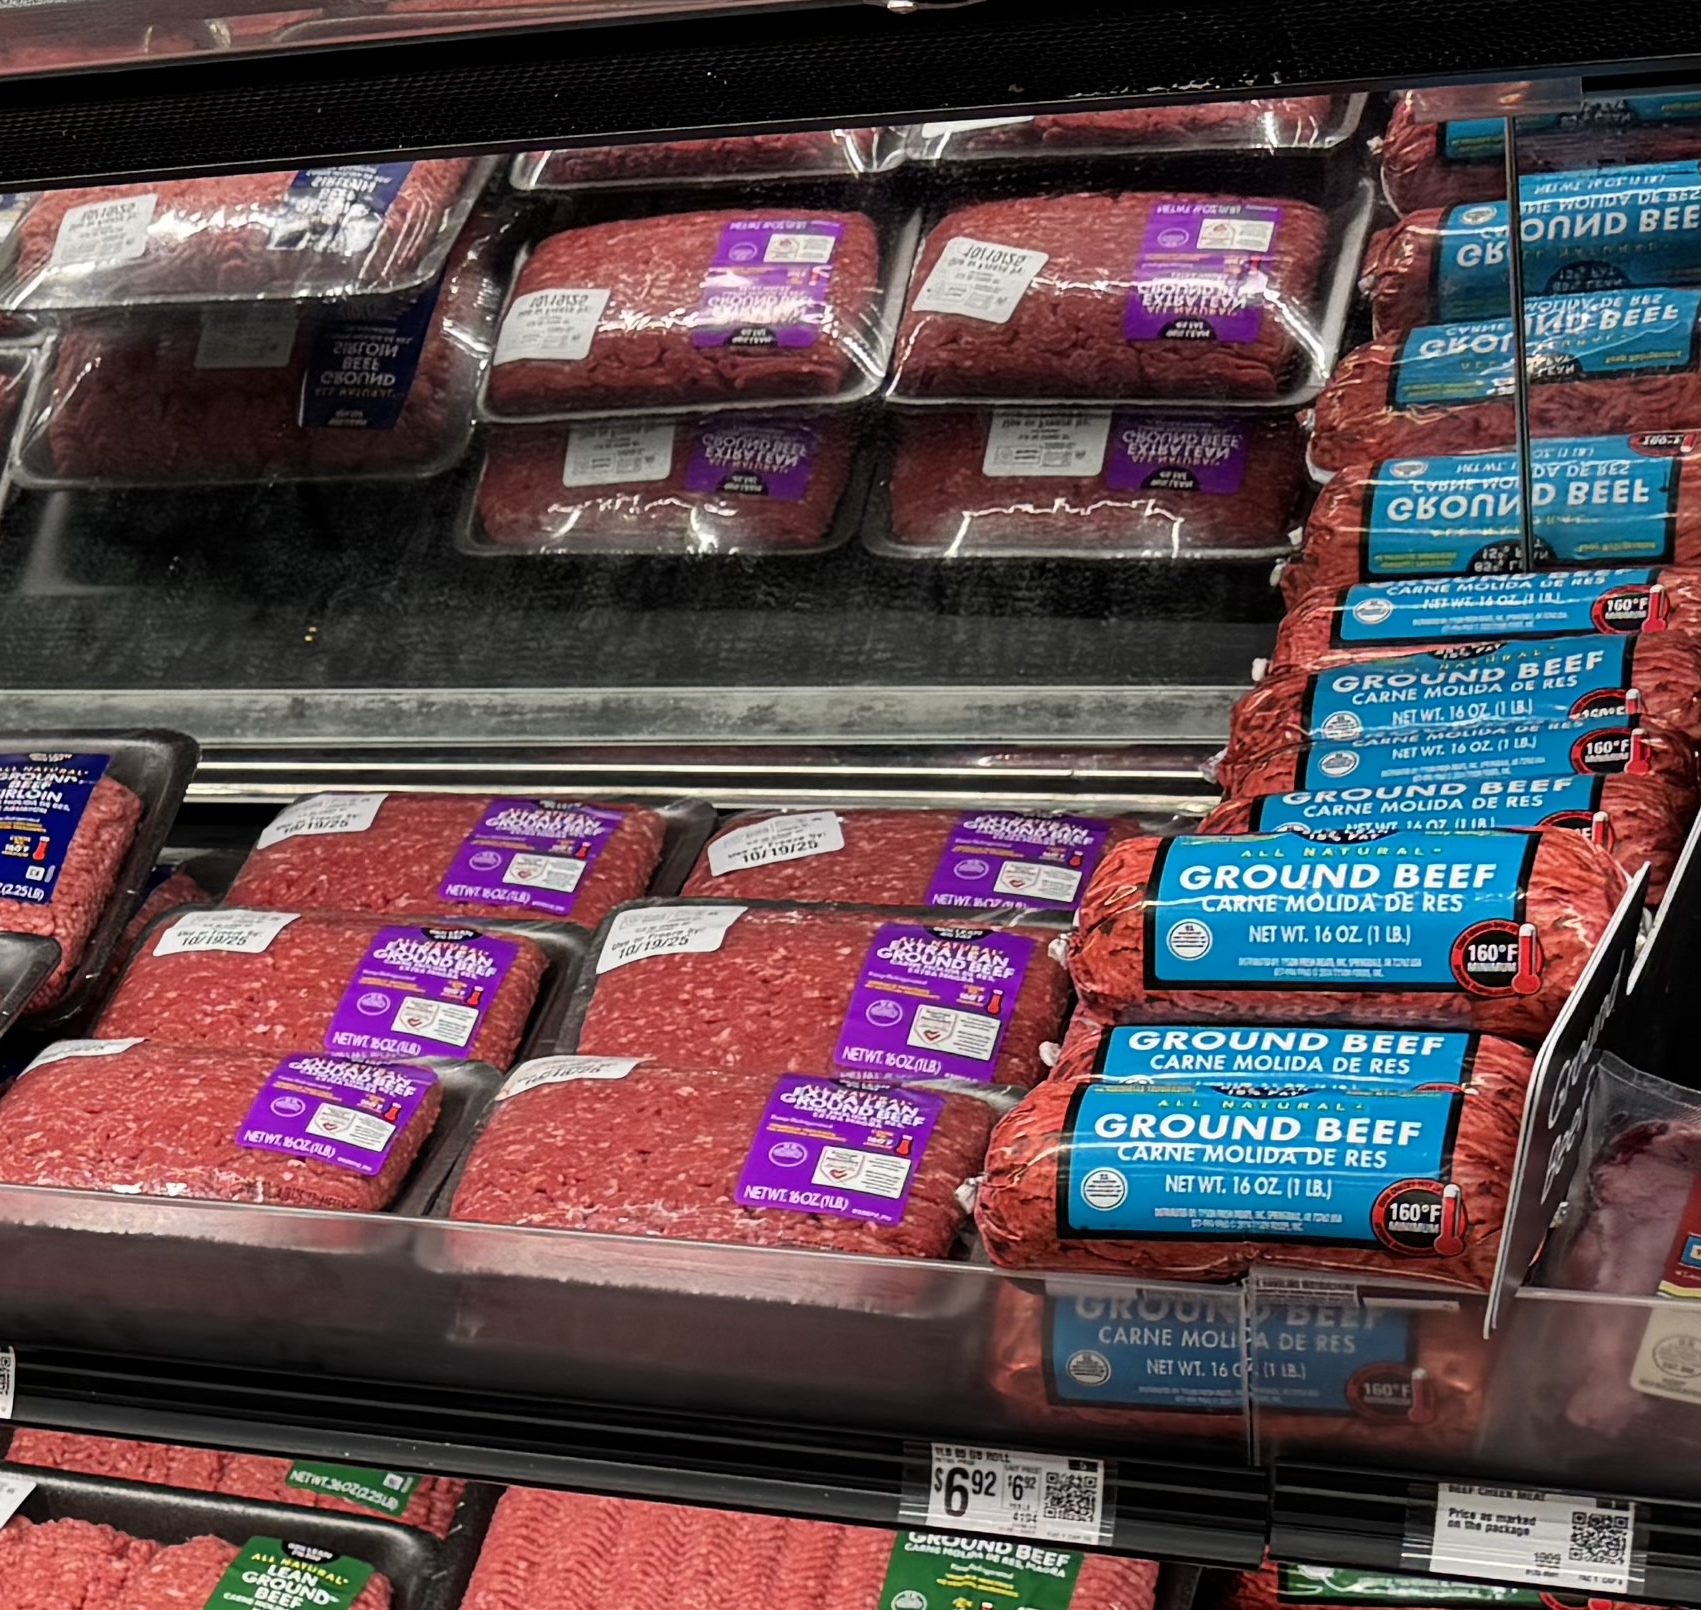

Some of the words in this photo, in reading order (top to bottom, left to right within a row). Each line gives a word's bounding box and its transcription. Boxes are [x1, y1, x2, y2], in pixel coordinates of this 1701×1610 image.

[1332, 668, 1509, 693] GROUND
[1517, 651, 1605, 680] BEEF
[1352, 689, 1417, 706] CARNE
[1425, 683, 1502, 699] MOLIDA
[1510, 680, 1536, 692] DE
[1543, 675, 1578, 690] RES
[1392, 711, 1418, 726] NET
[1420, 709, 1445, 723] WT.
[1449, 706, 1465, 719] 16
[1468, 703, 1491, 718] OZ.
[1282, 783, 1467, 805] GROUND
[1480, 778, 1574, 795] BEEF
[741, 840, 819, 865] 10/19/25
[1180, 863, 1380, 890] GROUND
[1392, 863, 1496, 889] BEEF
[1202, 894, 1277, 913] CARNE
[1285, 893, 1376, 913] MOLIDA
[1384, 894, 1413, 913] DE
[1422, 894, 1463, 913] RES
[180, 934, 248, 948] 10/19/25
[1250, 925, 1276, 943] NET
[1282, 926, 1309, 943] WT.
[1315, 925, 1332, 942] 16
[1336, 926, 1363, 943] OZ.
[1367, 925, 1381, 945] (1
[1385, 925, 1411, 945] LB.)
[1468, 944, 1518, 961] 160°F
[1128, 1031, 1329, 1053] GROUND
[1342, 1034, 1445, 1056] BEEF
[1094, 1114, 1301, 1141] GROUND
[1316, 1118, 1422, 1146] BEEF
[1117, 1145, 1205, 1162] CARNE
[1204, 1145, 1298, 1164] MOLIDA
[1306, 1148, 1335, 1167] DE
[1345, 1149, 1387, 1168] RES
[1389, 1203, 1441, 1222] 160°F
[1448, 1520, 1461, 1528] on
[1465, 1521, 1481, 1530] the
[1485, 1523, 1530, 1536] package
[1449, 1508, 1477, 1520] Price
[1479, 1512, 1492, 1521] as
[1496, 1514, 1536, 1526] marked
[267, 1564, 318, 1587] LEAN
[242, 1571, 330, 1606] GROUND
[254, 1587, 304, 1609] BEEF
